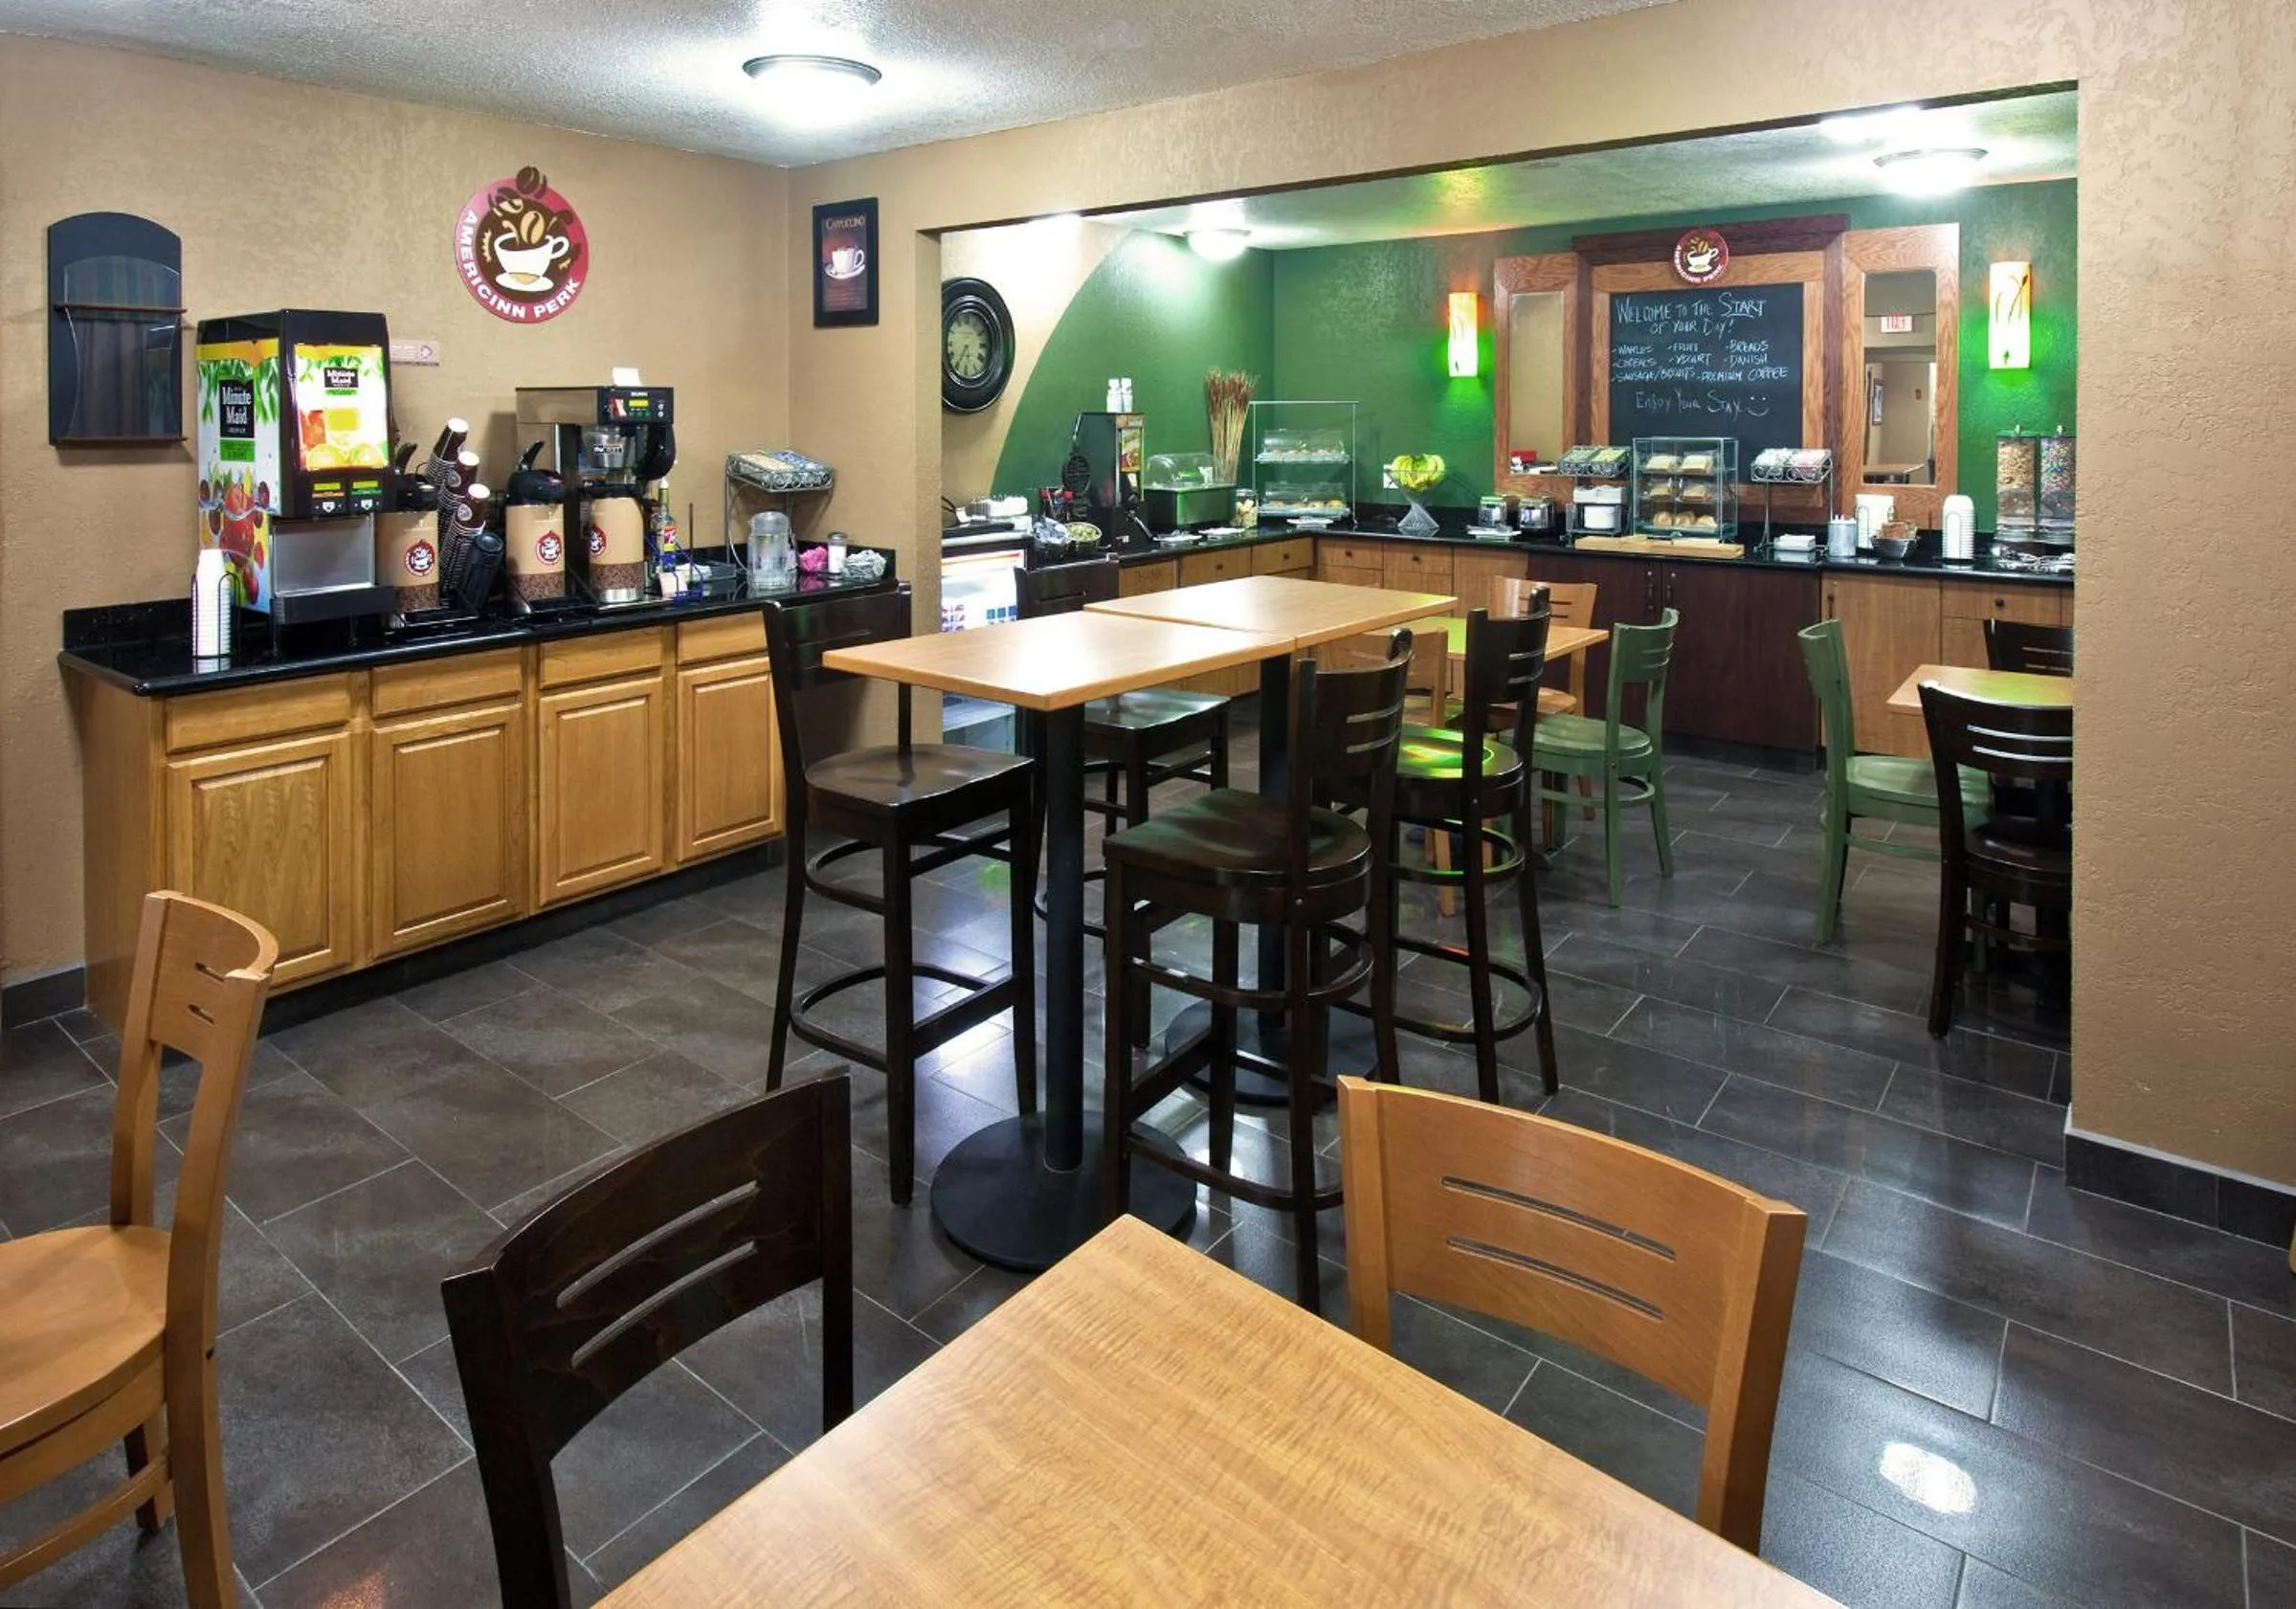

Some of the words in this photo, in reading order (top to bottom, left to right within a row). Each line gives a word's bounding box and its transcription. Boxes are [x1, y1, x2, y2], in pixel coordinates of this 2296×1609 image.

[458, 210, 525, 319] AMERICINN
[533, 278, 580, 318] PERK
[1615, 297, 1671, 324] WELCOME
[1676, 303, 1687, 318] TO
[1719, 291, 1767, 319] START
[1672, 320, 1698, 333] YOUR
[221, 387, 252, 405] Minute
[226, 406, 247, 424] Maid
